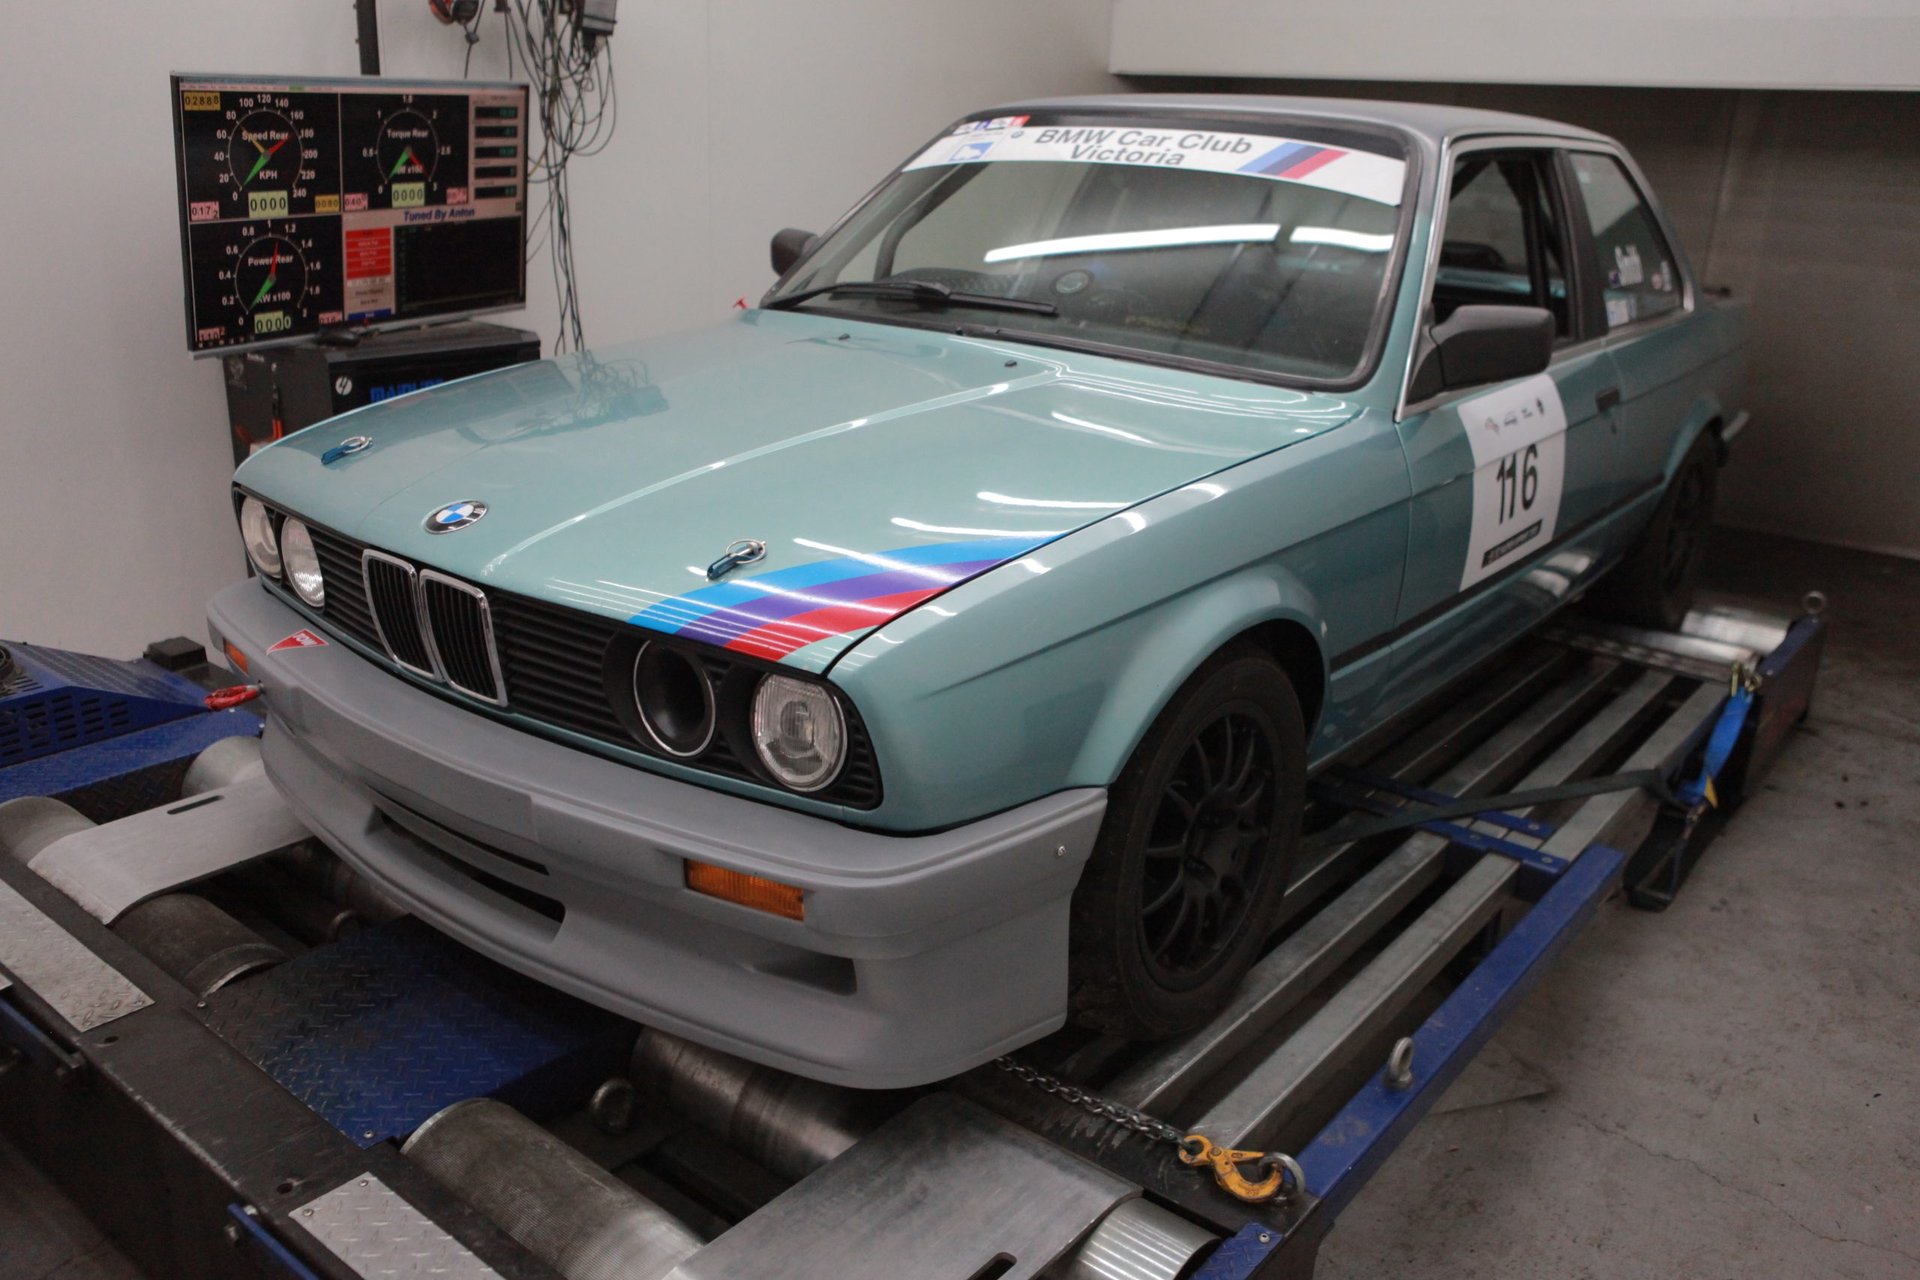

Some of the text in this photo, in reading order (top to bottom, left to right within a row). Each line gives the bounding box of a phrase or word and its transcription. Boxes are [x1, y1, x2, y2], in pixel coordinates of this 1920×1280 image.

[239, 98, 254, 108] 100
[257, 94, 272, 104] 120
[275, 98, 289, 107] 140
[226, 110, 236, 120] 80
[291, 110, 304, 120] 160
[216, 129, 227, 139] 60
[242, 131, 289, 141] Speed Rear
[301, 128, 314, 138] 180
[1035, 129, 1253, 154] BMW Car Club
[214, 151, 225, 161] 40
[304, 149, 318, 159] 200
[1070, 144, 1185, 165] Victoria
[219, 173, 229, 183] 20
[259, 170, 278, 180] KPH
[302, 170, 315, 180] 220
[232, 191, 238, 201] 0
[292, 188, 307, 198] 240
[393, 188, 423, 202] 0000
[250, 197, 287, 212] 0000
[404, 208, 475, 222] Tuned By Anton
[267, 220, 271, 228] 1
[285, 224, 296, 233] 1.2
[242, 227, 255, 236] 0.8
[302, 239, 313, 248] 1.4
[226, 245, 238, 255] 0.6
[248, 256, 273, 267] Power
[310, 261, 321, 271] 1.6
[219, 270, 231, 280] 0.4
[222, 295, 234, 306] 0.2
[238, 316, 244, 326] 0
[256, 315, 292, 333] 0000
[1496, 443, 1538, 525] 116
